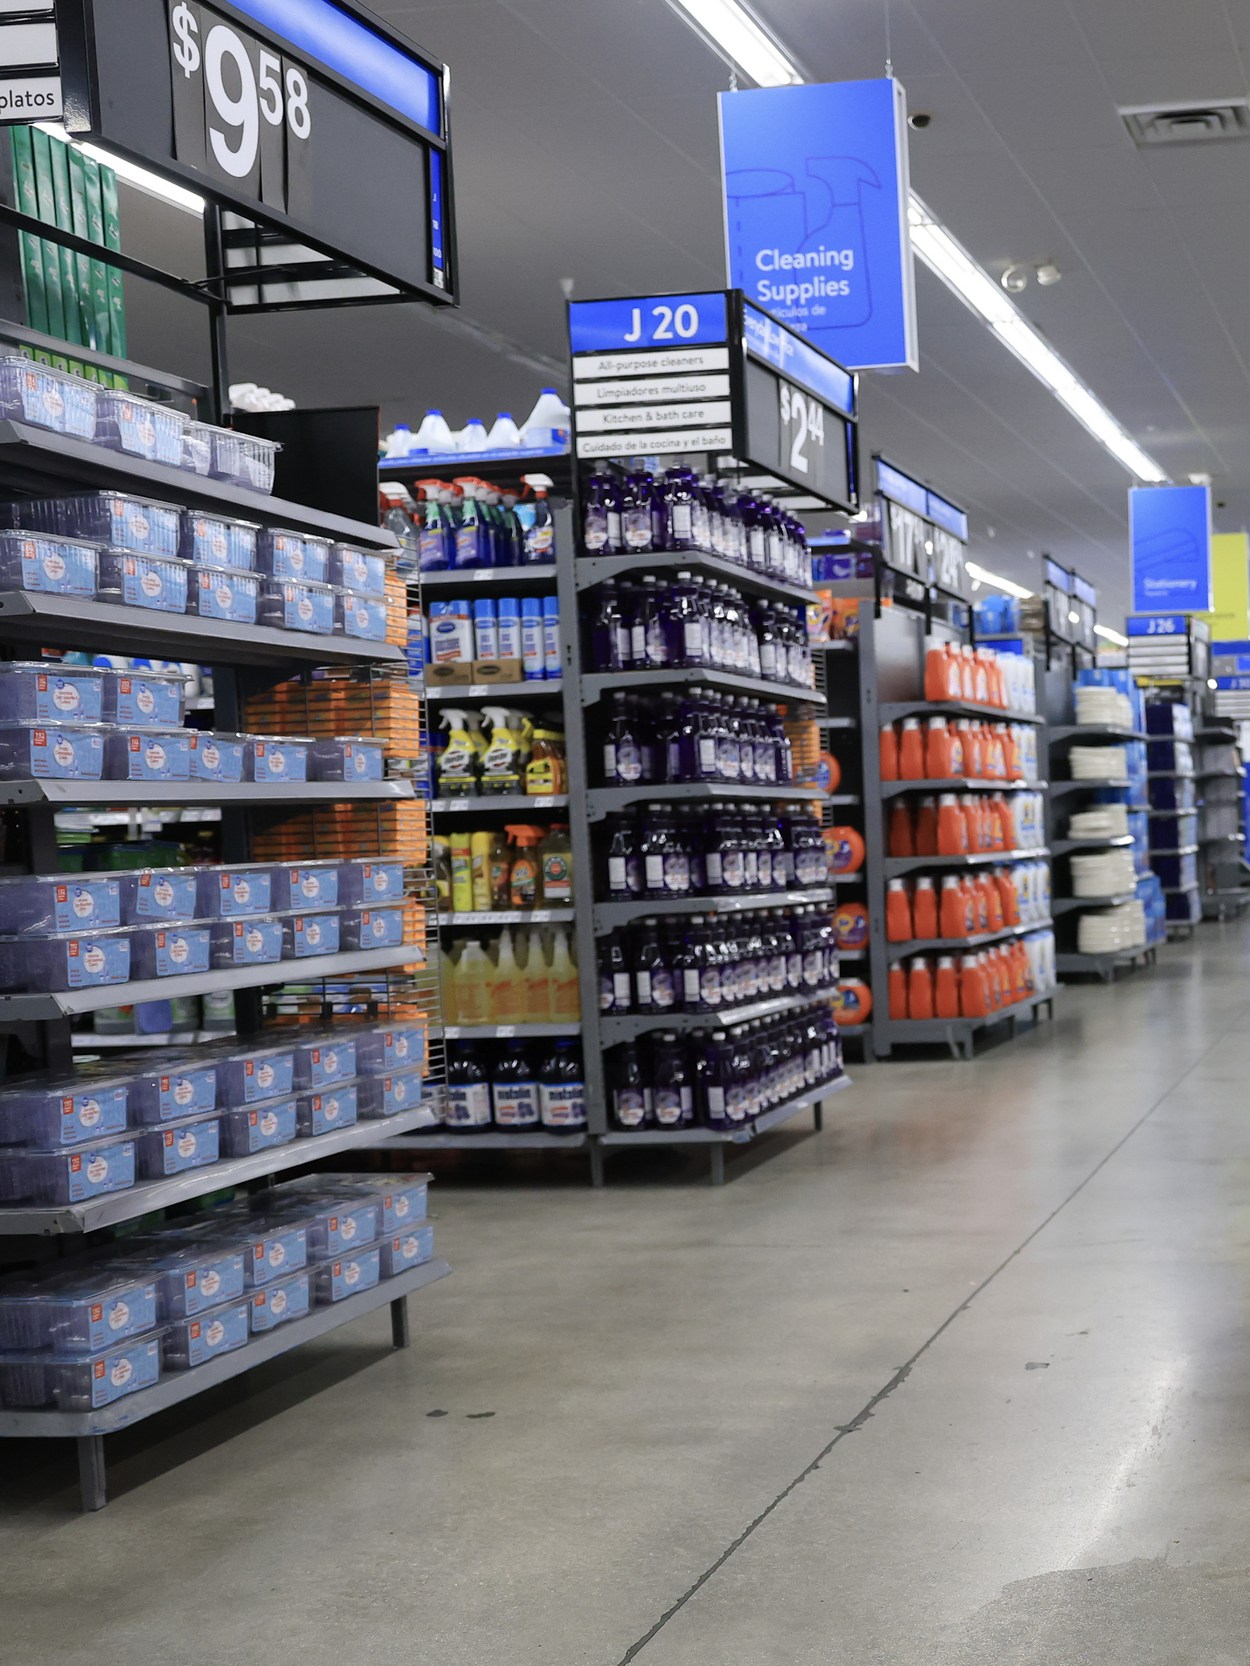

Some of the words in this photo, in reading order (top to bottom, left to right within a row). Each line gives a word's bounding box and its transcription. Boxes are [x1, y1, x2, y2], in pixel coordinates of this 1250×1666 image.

[755, 245, 854, 272] Cleaning
[757, 276, 850, 306] Supplies
[624, 308, 642, 342] J
[652, 304, 699, 340] 20
[598, 359, 658, 372] All-purpose
[660, 356, 704, 368] cleaners
[597, 384, 659, 399] Limpiadores
[662, 382, 706, 396] multiuso
[603, 411, 643, 424] Kitchen
[645, 411, 652, 422] &
[655, 409, 679, 421] bath
[682, 410, 705, 420] care
[582, 440, 622, 454] Cuidado
[625, 438, 638, 451] de
[639, 437, 648, 450] la
[649, 436, 682, 449] cocina
[682, 438, 689, 450] y
[690, 434, 699, 446] el
[702, 434, 726, 446] baño
[1143, 577, 1198, 590] Stationery
[1146, 619, 1156, 634] J
[1157, 617, 1176, 634] 26
